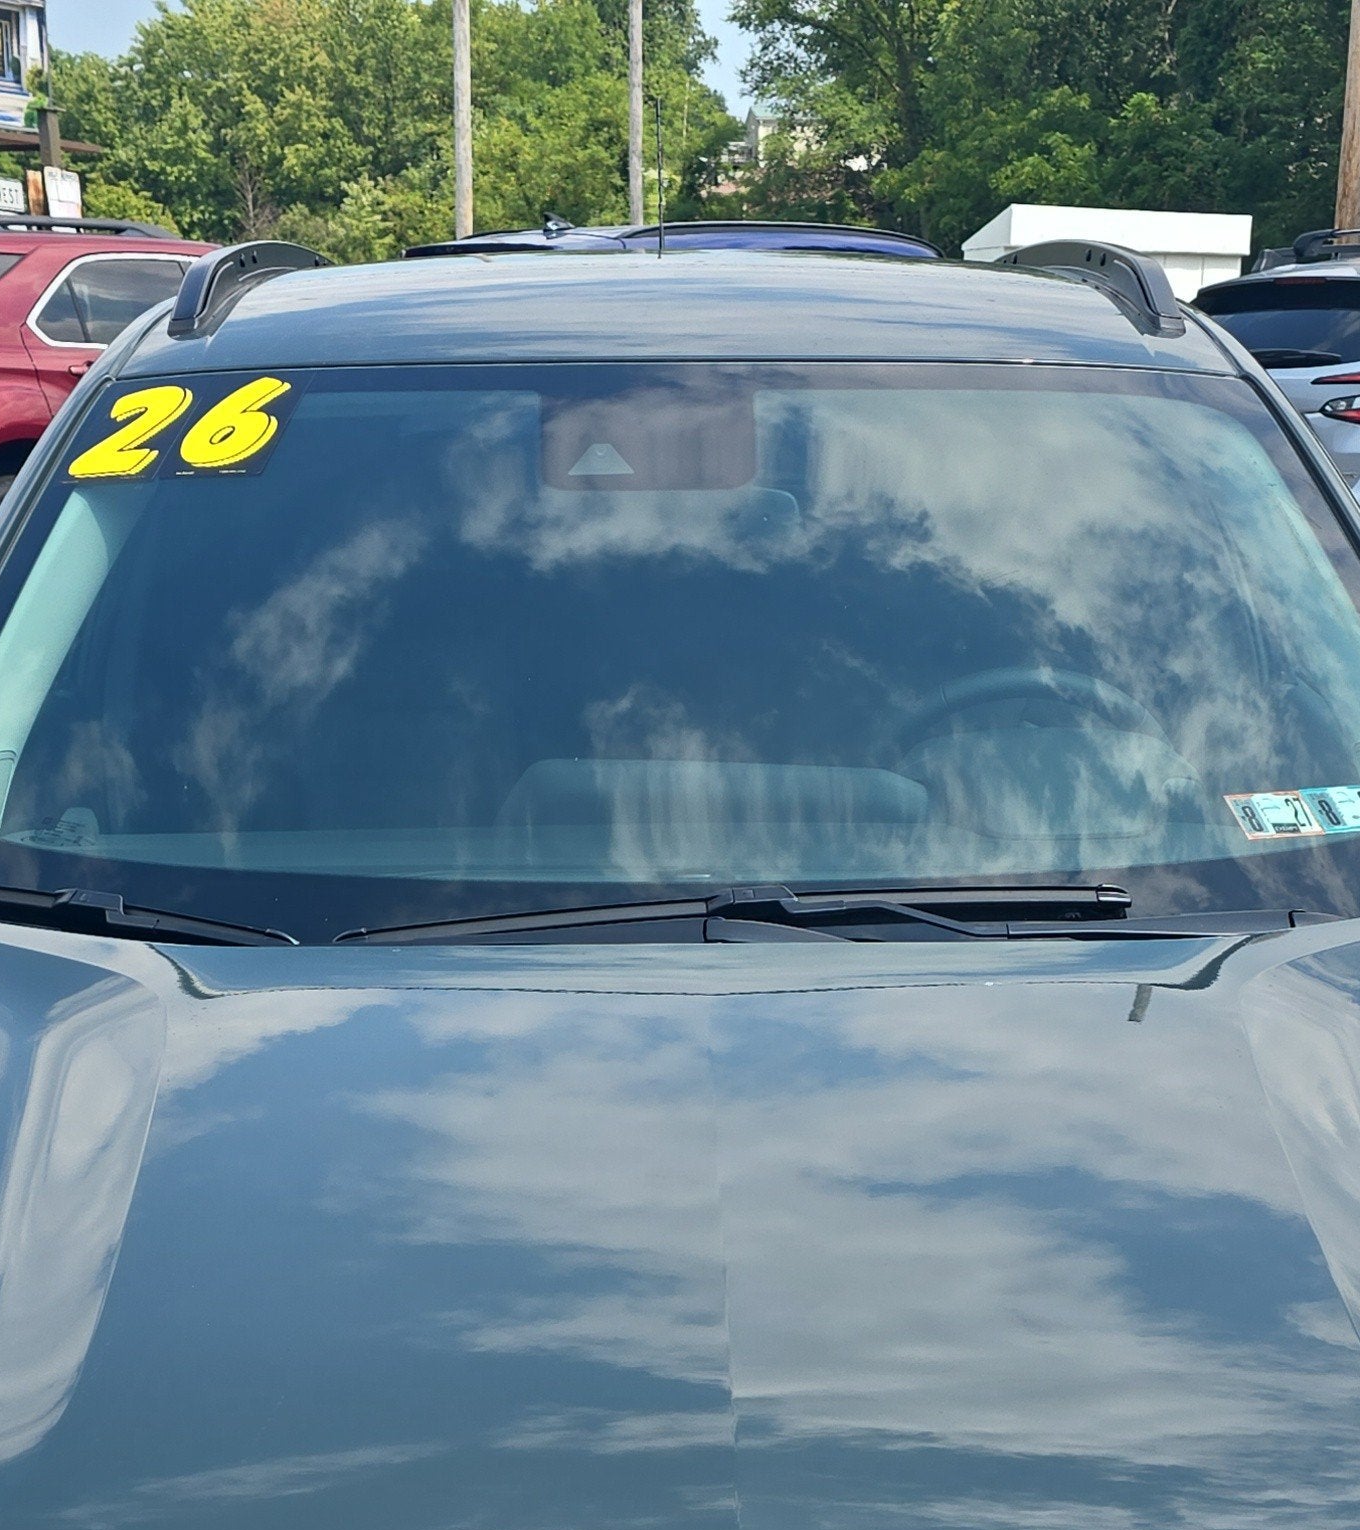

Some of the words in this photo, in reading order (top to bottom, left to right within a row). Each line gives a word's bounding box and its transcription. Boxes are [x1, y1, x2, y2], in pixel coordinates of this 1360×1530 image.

[68, 377, 291, 478] 26
[1241, 806, 1264, 832] 8
[1285, 798, 1313, 828] 27
[1318, 800, 1341, 826] 8
